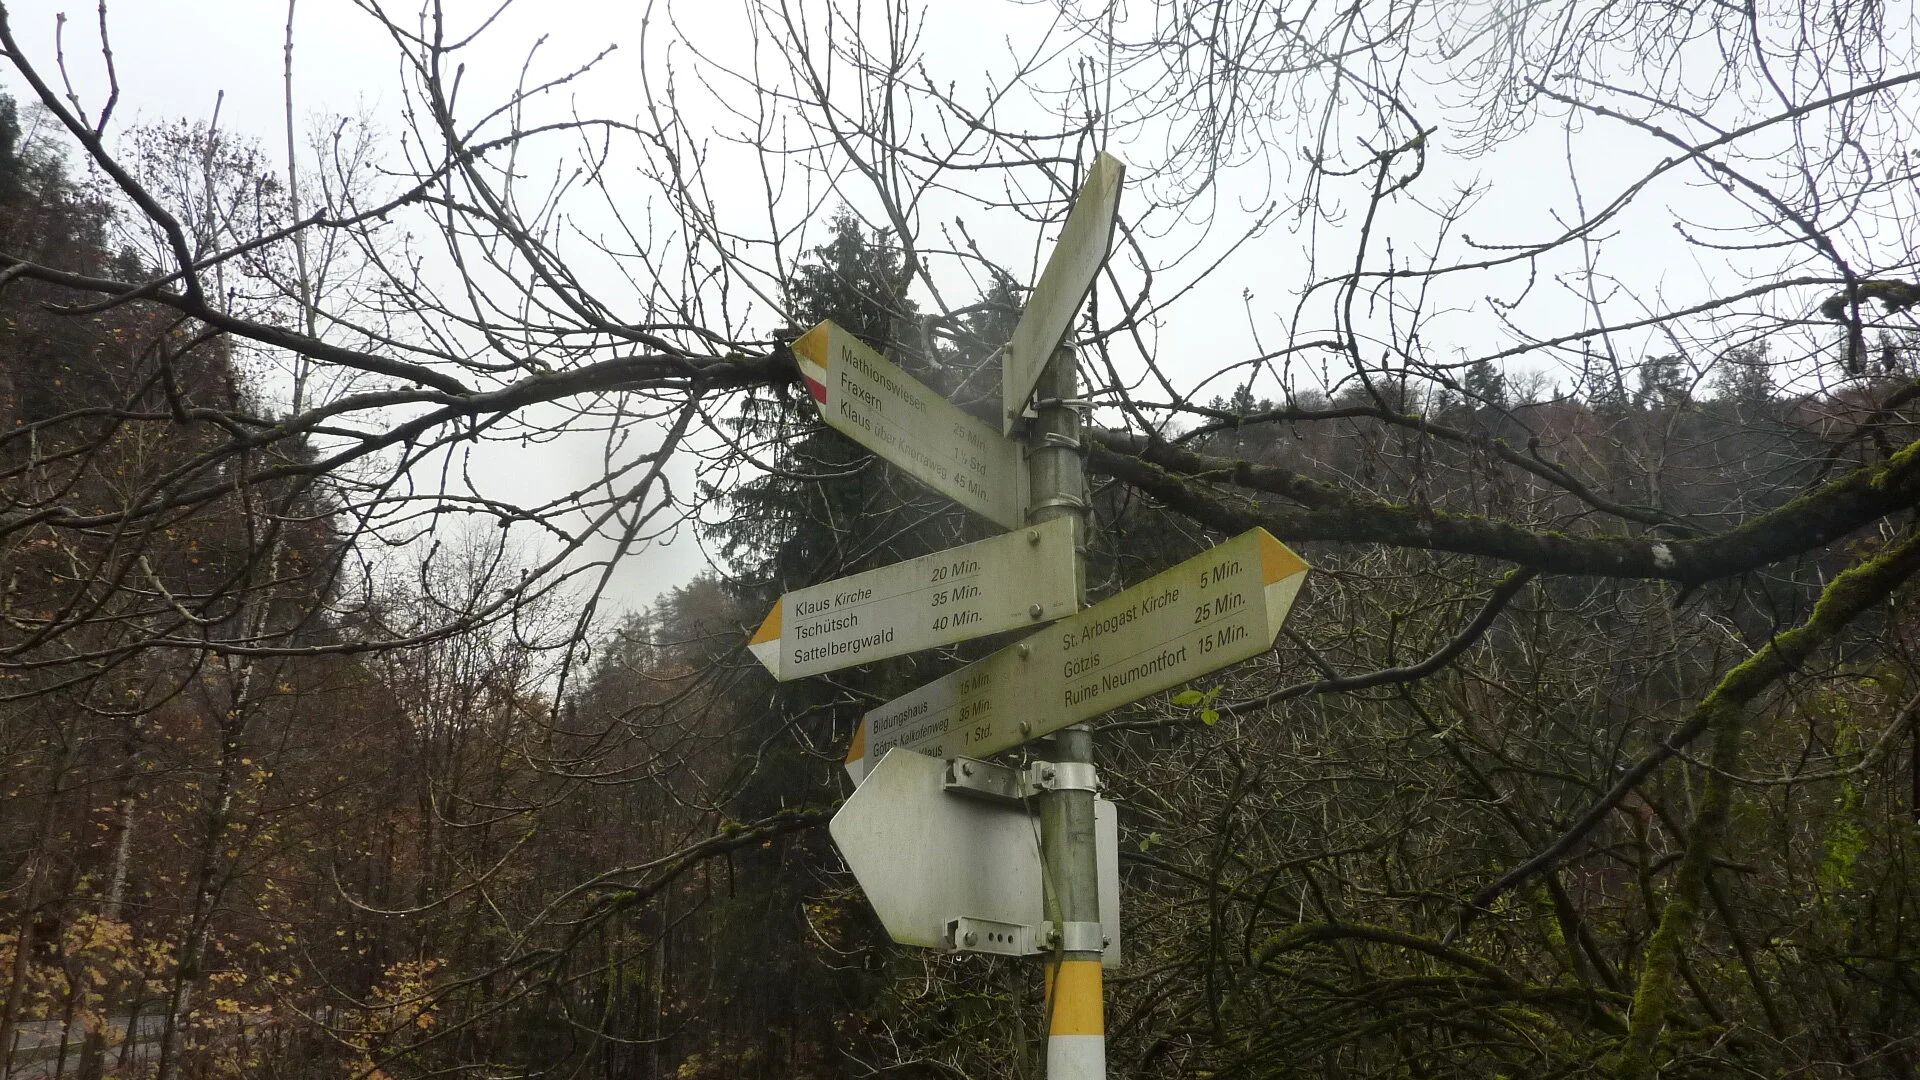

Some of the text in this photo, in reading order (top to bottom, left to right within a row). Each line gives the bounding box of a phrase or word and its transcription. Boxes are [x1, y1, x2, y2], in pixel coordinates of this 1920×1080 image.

[841, 371, 881, 412] Fraxern
[970, 457, 988, 477] Std.
[842, 345, 926, 414] Mathionswiesen
[953, 422, 965, 438] 25
[840, 399, 989, 502] Klaus über Knorraweg 45 Min.
[795, 560, 981, 616] Klaus Kirche 20 Min.
[795, 585, 981, 640] Tschütsch 35 Min.
[1063, 560, 1243, 651] St. Arbogast Kirche 5 Min.
[794, 610, 982, 664] Sattelbergwald 40 Min.
[1063, 592, 1246, 678] Götzis 25 Min.
[1064, 624, 1248, 708] Ruine Neumontfort 15 Min.
[873, 672, 991, 735] Bildungshaus 15 Min.
[899, 717, 949, 748] Kalkofenweg
[959, 706, 970, 722] 35
[972, 699, 992, 717] Min.
[965, 731, 969, 746] 1
[974, 723, 993, 742] Std.
